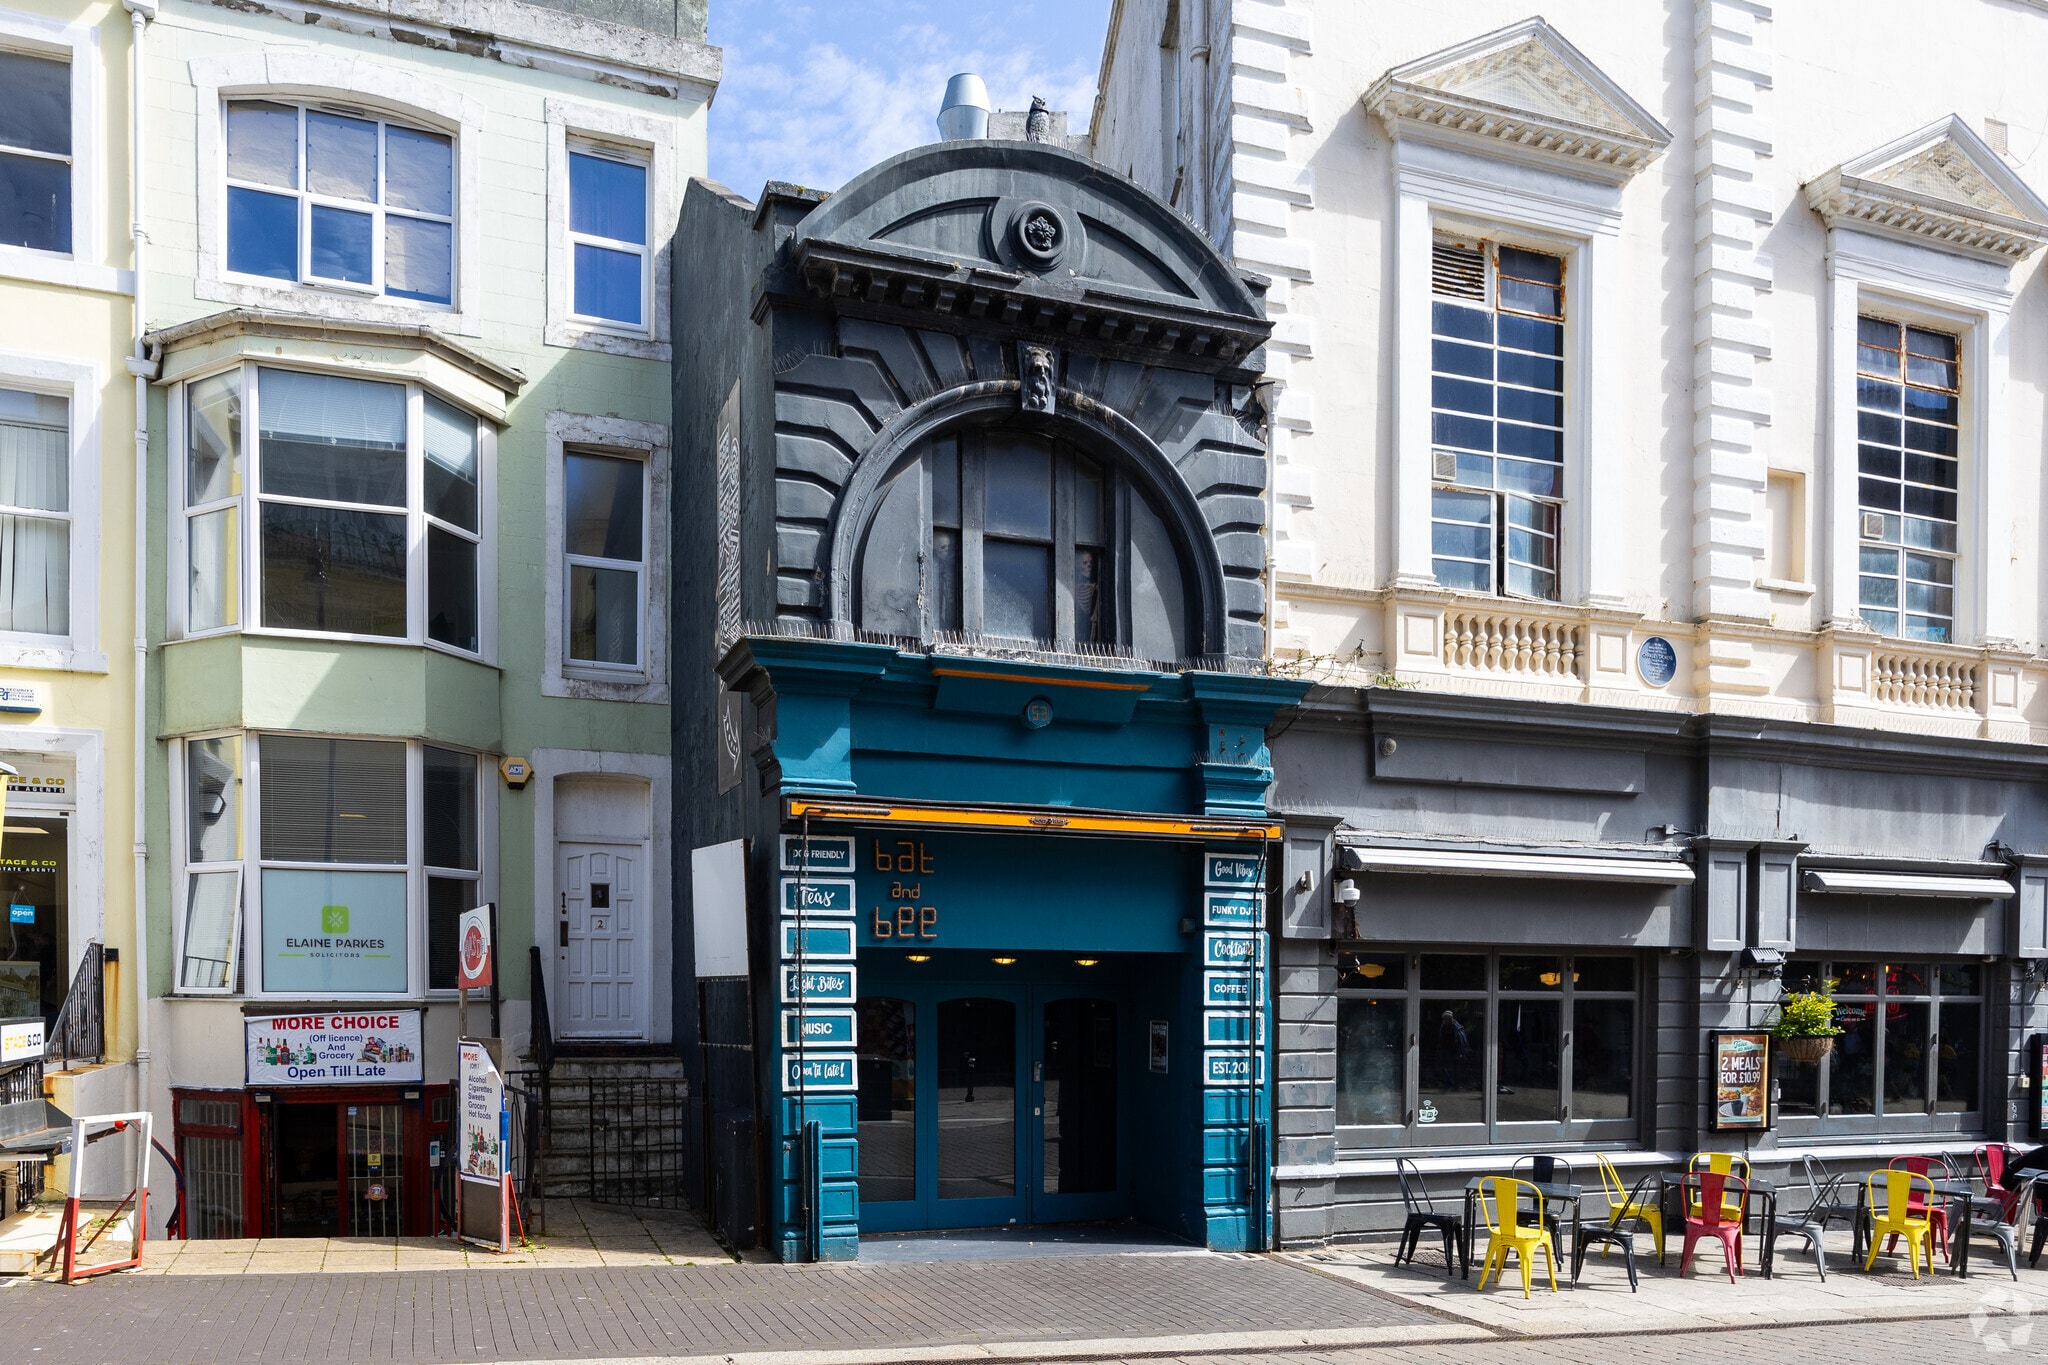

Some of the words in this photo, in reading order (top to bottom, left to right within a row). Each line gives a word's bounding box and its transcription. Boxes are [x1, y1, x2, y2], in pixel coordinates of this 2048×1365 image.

[509, 766, 524, 774] ADT
[46, 777, 65, 785] CO
[25, 785, 64, 793] AGENTS
[811, 849, 845, 859] FRIENDLY
[875, 839, 934, 873] bat
[0, 858, 27, 866] TACE
[1215, 860, 1233, 877] Good
[1235, 862, 1253, 878] Vibes
[892, 881, 921, 899] and
[798, 886, 835, 907] Teas
[12, 909, 33, 918] open
[1212, 905, 1238, 915] FUNKY
[596, 920, 604, 929] 2
[875, 906, 937, 938] bee
[286, 938, 331, 948] ELAINE
[336, 939, 385, 949] PARKES
[1214, 940, 1254, 958] Cocktail
[789, 974, 817, 993] Lght
[817, 975, 845, 992] Bites
[1213, 984, 1248, 994] COFFEE
[1836, 1006, 1866, 1017] Welcome
[272, 1016, 325, 1030] MORE
[331, 1015, 400, 1030] CHOICE
[802, 1022, 833, 1035] MUSIC
[309, 1034, 327, 1044] (Off
[328, 1033, 363, 1043] licence)
[319, 1051, 355, 1061] Grocery
[463, 1052, 479, 1061] MORE
[1212, 1062, 1231, 1075] EST.
[1232, 1062, 1250, 1074] 201
[1721, 1056, 1729, 1071] 2
[1731, 1056, 1761, 1071] MEALS
[287, 1066, 326, 1080] Open
[330, 1066, 351, 1077] Till
[356, 1065, 386, 1077] Late
[824, 1062, 845, 1079] late!
[468, 1075, 487, 1084] Alcohol
[1720, 1072, 1737, 1084] FOR
[1739, 1071, 1761, 1084] £10.99
[468, 1083, 493, 1094] Cigarettes
[468, 1092, 486, 1102] Sweets
[468, 1101, 487, 1112] Grocery
[468, 1110, 477, 1118] Hot
[478, 1111, 492, 1121] foods
